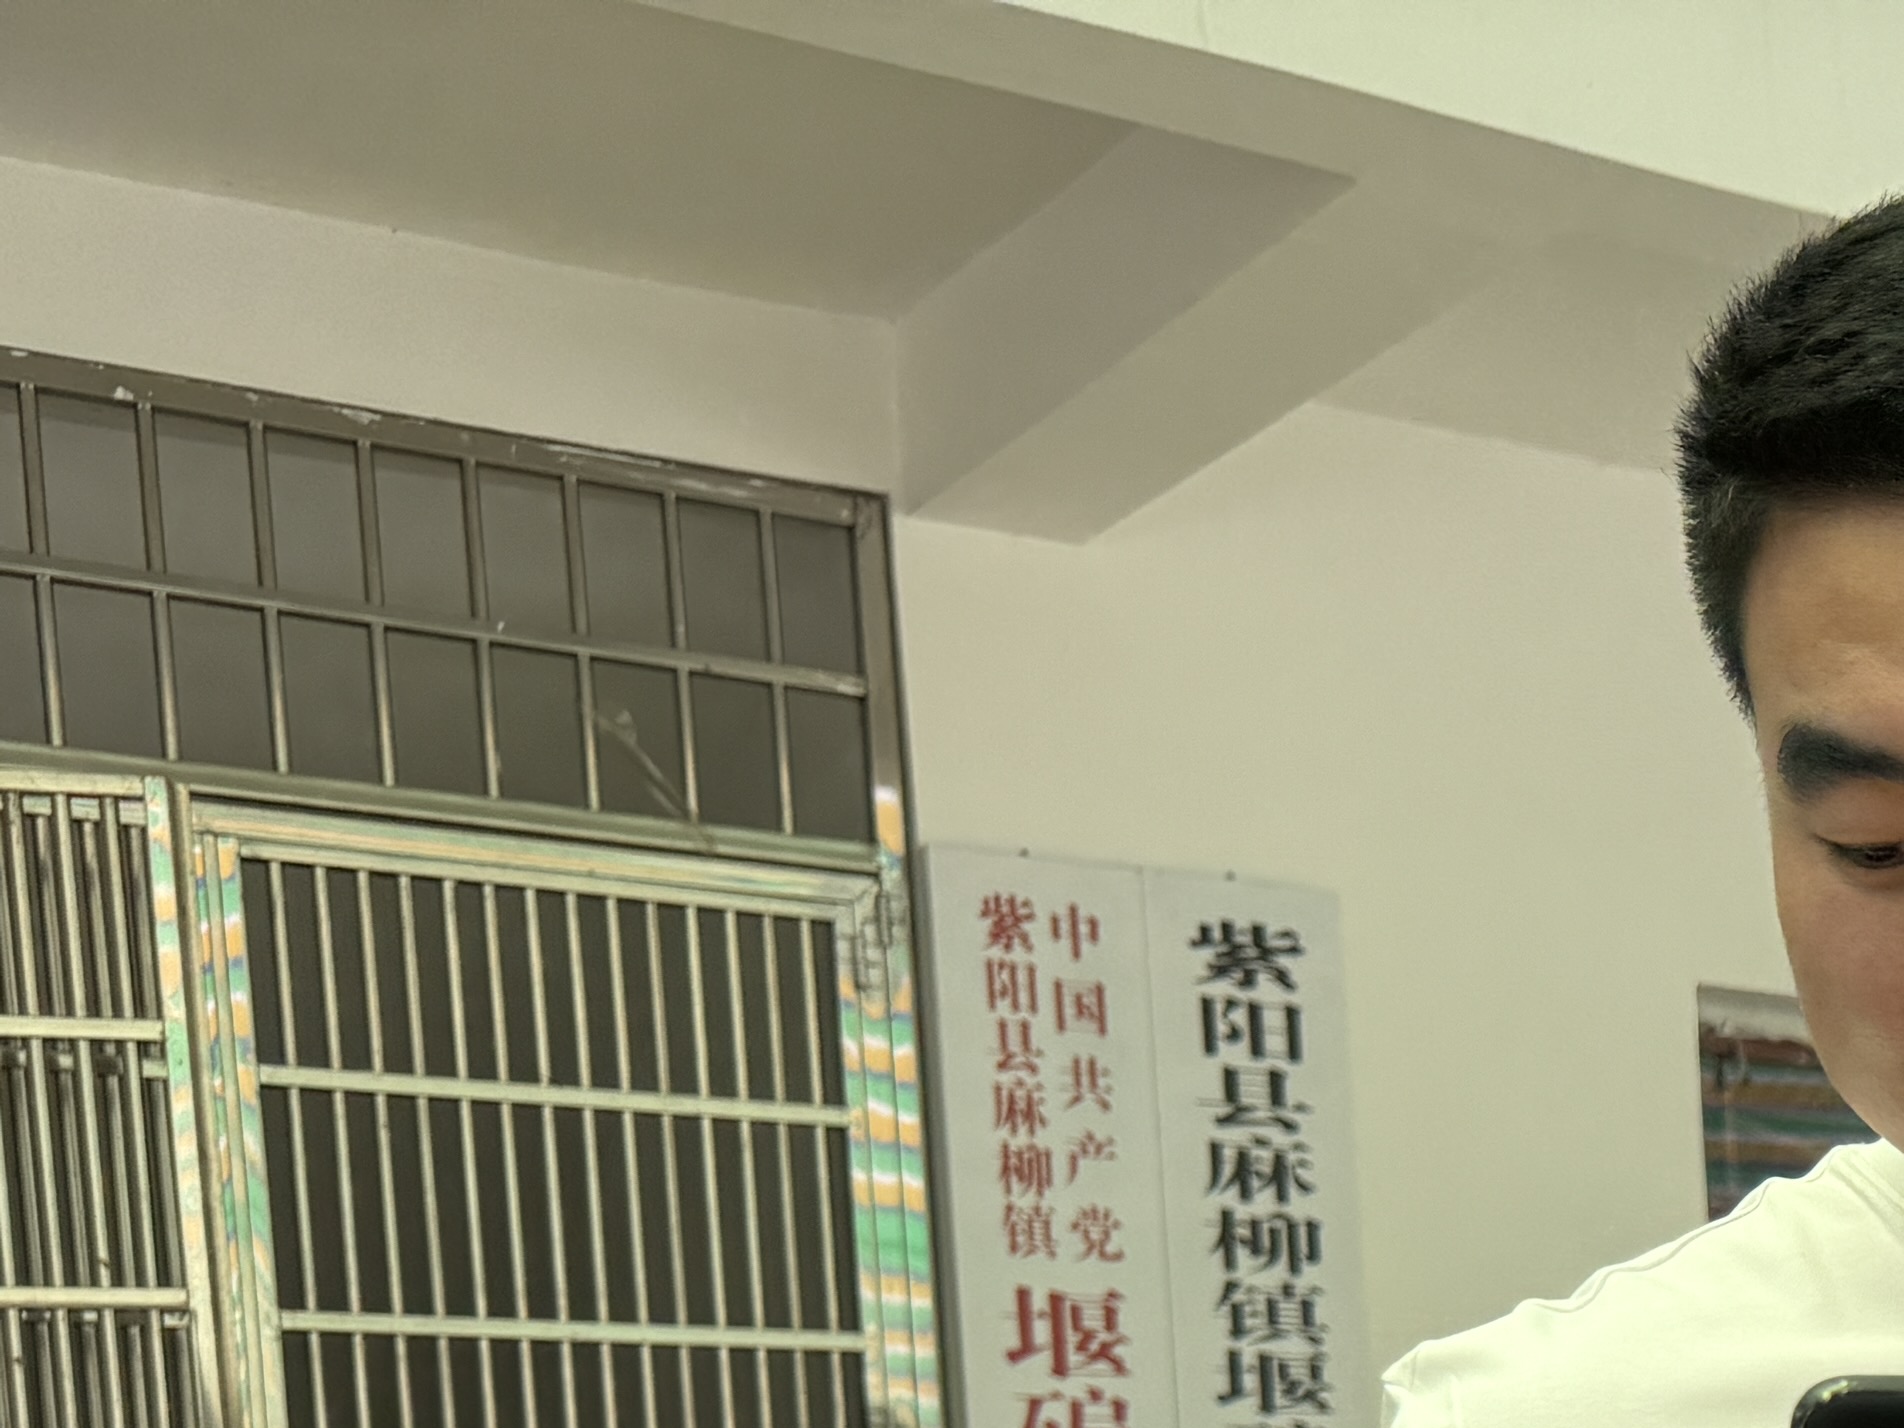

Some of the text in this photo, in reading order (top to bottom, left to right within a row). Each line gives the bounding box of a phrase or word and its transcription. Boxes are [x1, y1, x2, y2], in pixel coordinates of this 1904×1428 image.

[979, 890, 1058, 1262] 紫阳县麻柳镇
[1048, 901, 1126, 1264] 中国共产党
